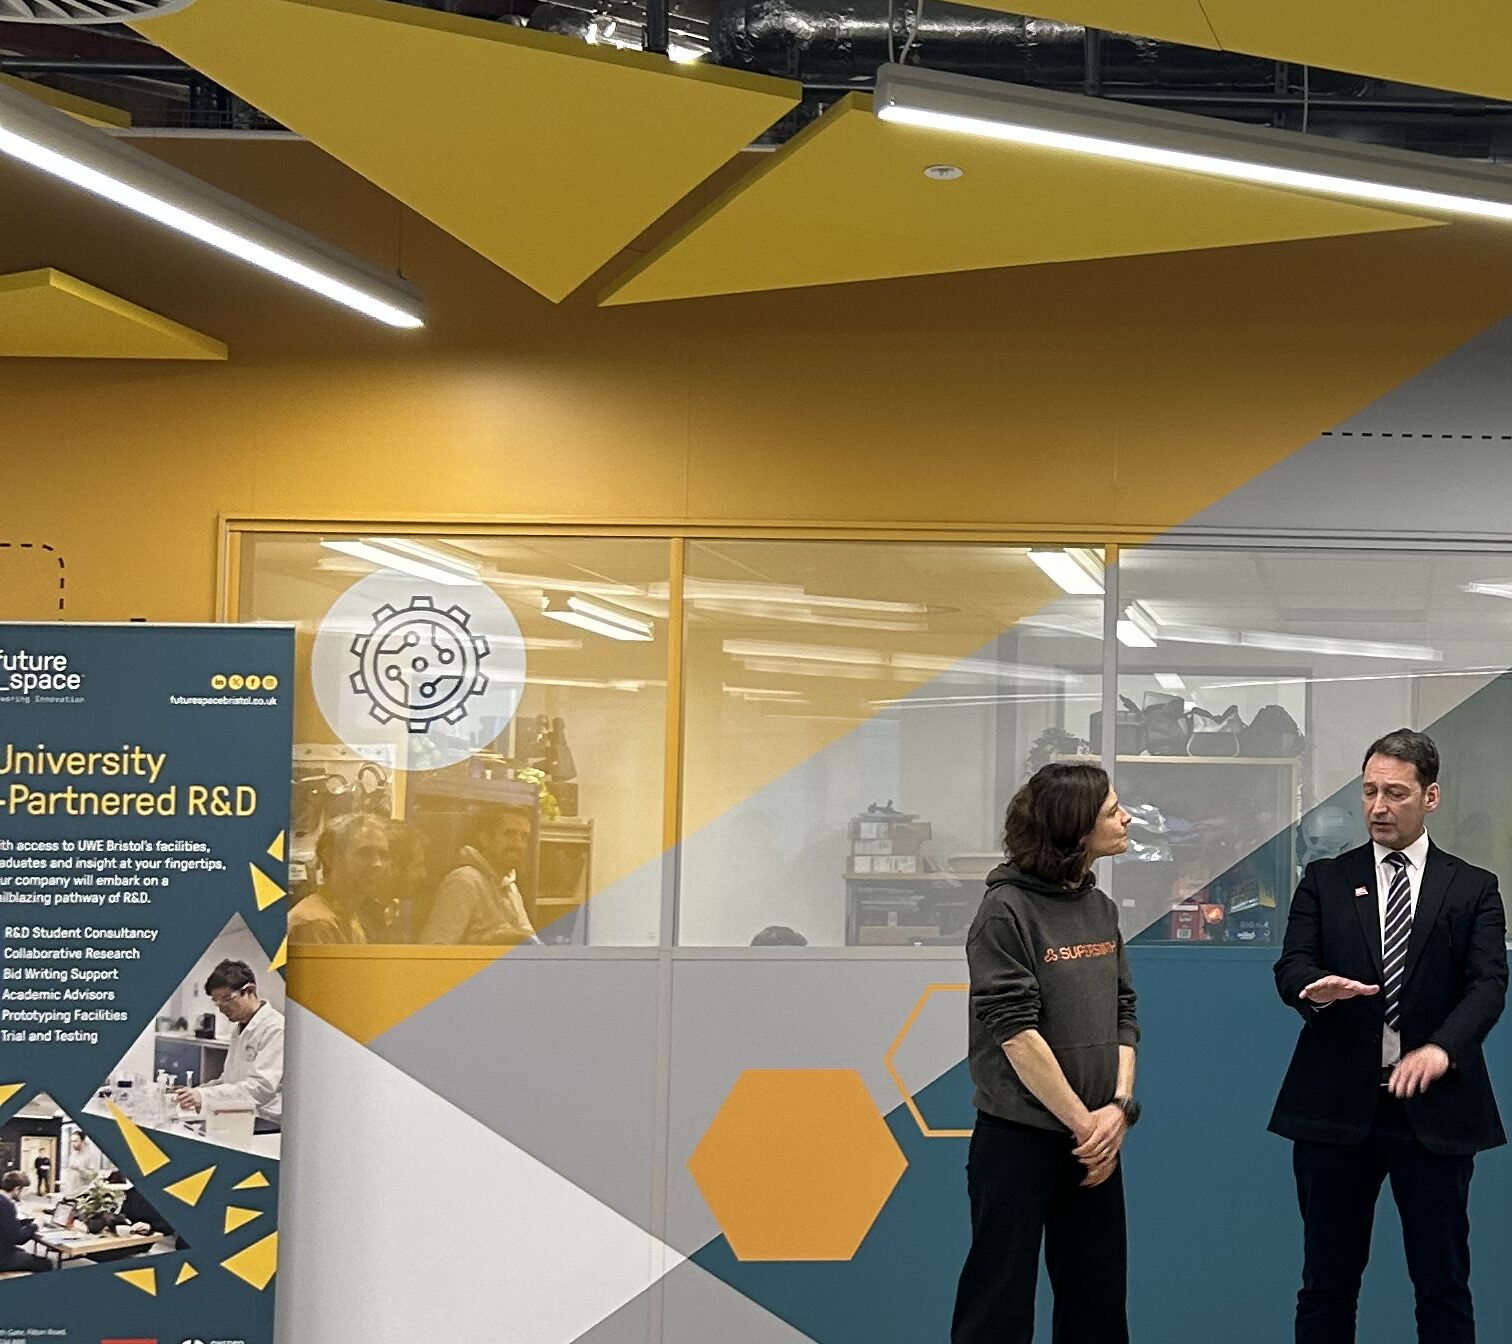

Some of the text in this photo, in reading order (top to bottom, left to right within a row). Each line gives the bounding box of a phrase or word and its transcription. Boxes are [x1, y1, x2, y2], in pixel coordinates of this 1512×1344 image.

[188, 785, 257, 817] R&D
[16, 842, 60, 852] access
[62, 840, 75, 852] to
[78, 840, 104, 852] UWE
[106, 840, 153, 852] Bristol's
[156, 840, 211, 853] facilities,
[50, 857, 73, 869] and
[76, 857, 117, 872] insight
[119, 858, 133, 869] at
[135, 860, 162, 872] your
[165, 857, 227, 872] fingertips,
[15, 877, 71, 888] company
[73, 874, 94, 886] will
[96, 875, 141, 886] embark
[143, 877, 159, 886] on
[161, 877, 169, 886] a
[54, 892, 106, 905] pathway
[108, 892, 121, 903] of
[123, 892, 152, 904] R&D.
[5, 927, 159, 942] R&D Student Consultancy
[4, 947, 141, 960] Collaborative Research
[3, 968, 120, 983] Bid Writing Support
[1, 988, 116, 1001] Academic Advisors
[1, 1009, 128, 1024] Prototyping Facilities
[0, 1030, 99, 1045] Trial and Testing
